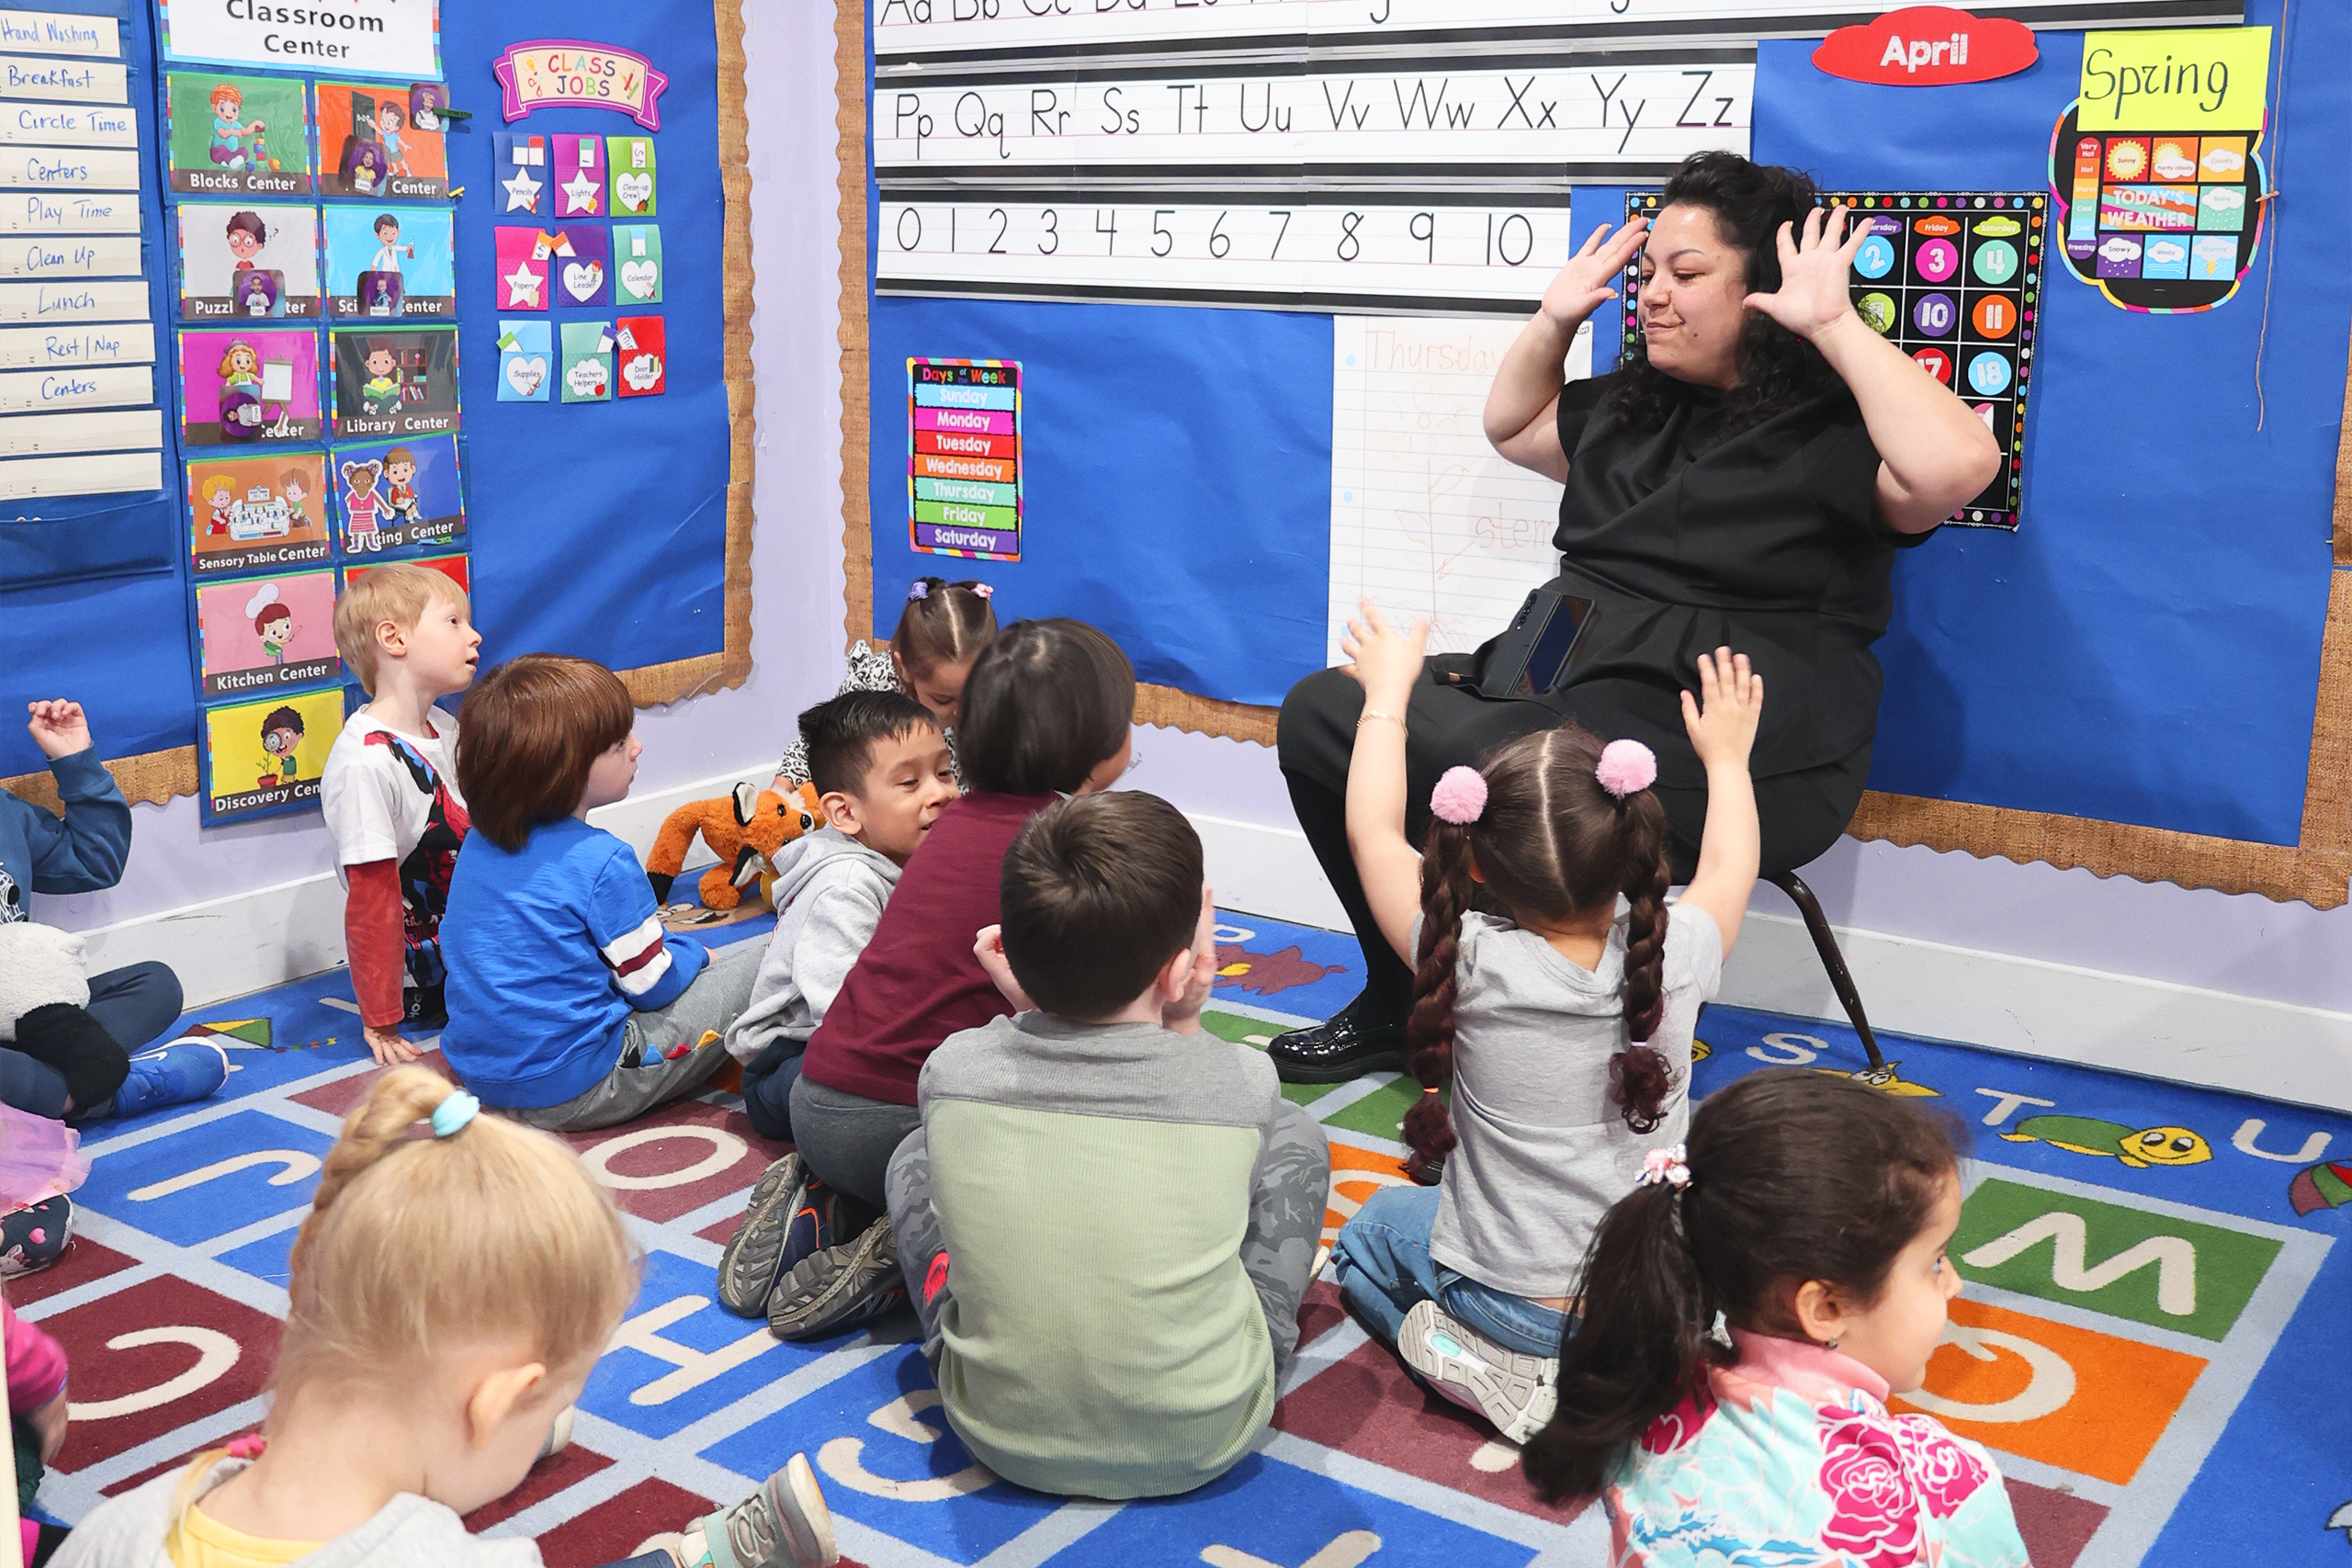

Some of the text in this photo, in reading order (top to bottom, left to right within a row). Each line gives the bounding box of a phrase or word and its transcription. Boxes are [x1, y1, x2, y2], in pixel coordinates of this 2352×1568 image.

[226, 0, 384, 32] Classroom
[1, 17, 98, 50] Hand Washing
[264, 34, 350, 59] Center
[1880, 33, 1968, 73] April
[548, 53, 616, 76] CLASS
[8, 65, 95, 88] Breakfast
[557, 75, 610, 96] JOBS
[2085, 49, 2229, 119] Spring
[19, 110, 127, 131] Circle Time
[897, 71, 1734, 160] Pp Qq Rr Ss Tt Uu Vv Ww Xx Yy Zz
[2081, 142, 2098, 151] Very
[28, 158, 87, 181] Centers
[190, 174, 296, 191] Blocks Center
[392, 181, 437, 195] Center
[512, 187, 533, 196] Pencils
[571, 189, 591, 198] Lights
[623, 184, 650, 192] Clean-up
[2113, 190, 2185, 206] TODAY'S
[28, 197, 112, 225] Play Time
[2107, 211, 2188, 228] WEATHER
[897, 207, 922, 251] 0
[988, 209, 1008, 254] 2
[1037, 209, 1058, 254] 3
[1095, 209, 1118, 256] 4
[1150, 210, 1175, 257] 5
[1209, 210, 1230, 259] 6
[1269, 211, 1291, 260] 7
[1337, 211, 1364, 261] 8
[1409, 212, 1434, 265] 9
[1487, 213, 1532, 265] 10
[1870, 224, 1897, 232] ursday
[1925, 224, 1949, 232] Friday
[1981, 223, 2016, 232] Saturday
[27, 244, 95, 270] Clean Up
[1864, 244, 1885, 271] 2
[2068, 243, 2096, 253] Freezing
[1928, 247, 1945, 274] 3
[1986, 249, 2006, 275] 4
[514, 282, 535, 290] Papers
[573, 280, 596, 288] Leader
[38, 286, 95, 314] Lunch
[401, 299, 442, 313] enter
[1921, 302, 1949, 328] 10
[1985, 303, 2002, 330] 11
[514, 370, 540, 379] Supplies
[574, 379, 597, 388] Helpers
[922, 367, 954, 384] Days
[970, 369, 1006, 384] Week
[1976, 360, 2003, 387] 18
[42, 377, 96, 400] Centers
[940, 389, 988, 407] Sunday
[346, 417, 449, 434] Library Center
[937, 411, 990, 432] Monday
[936, 434, 991, 456] Tuesday
[926, 457, 1002, 481] Wednesday
[933, 482, 995, 502] Thursday
[943, 506, 986, 526] Friday
[1476, 502, 1553, 551] stem
[411, 523, 454, 539] Center
[934, 528, 996, 551] Saturday
[198, 546, 325, 570] Sensory Table Center
[217, 665, 327, 690] Kitchen Center
[215, 784, 321, 812] Discovery Cen
[1746, 1033, 1828, 1065] S
[1975, 1088, 2055, 1125] T
[2232, 1118, 2333, 1163] U
